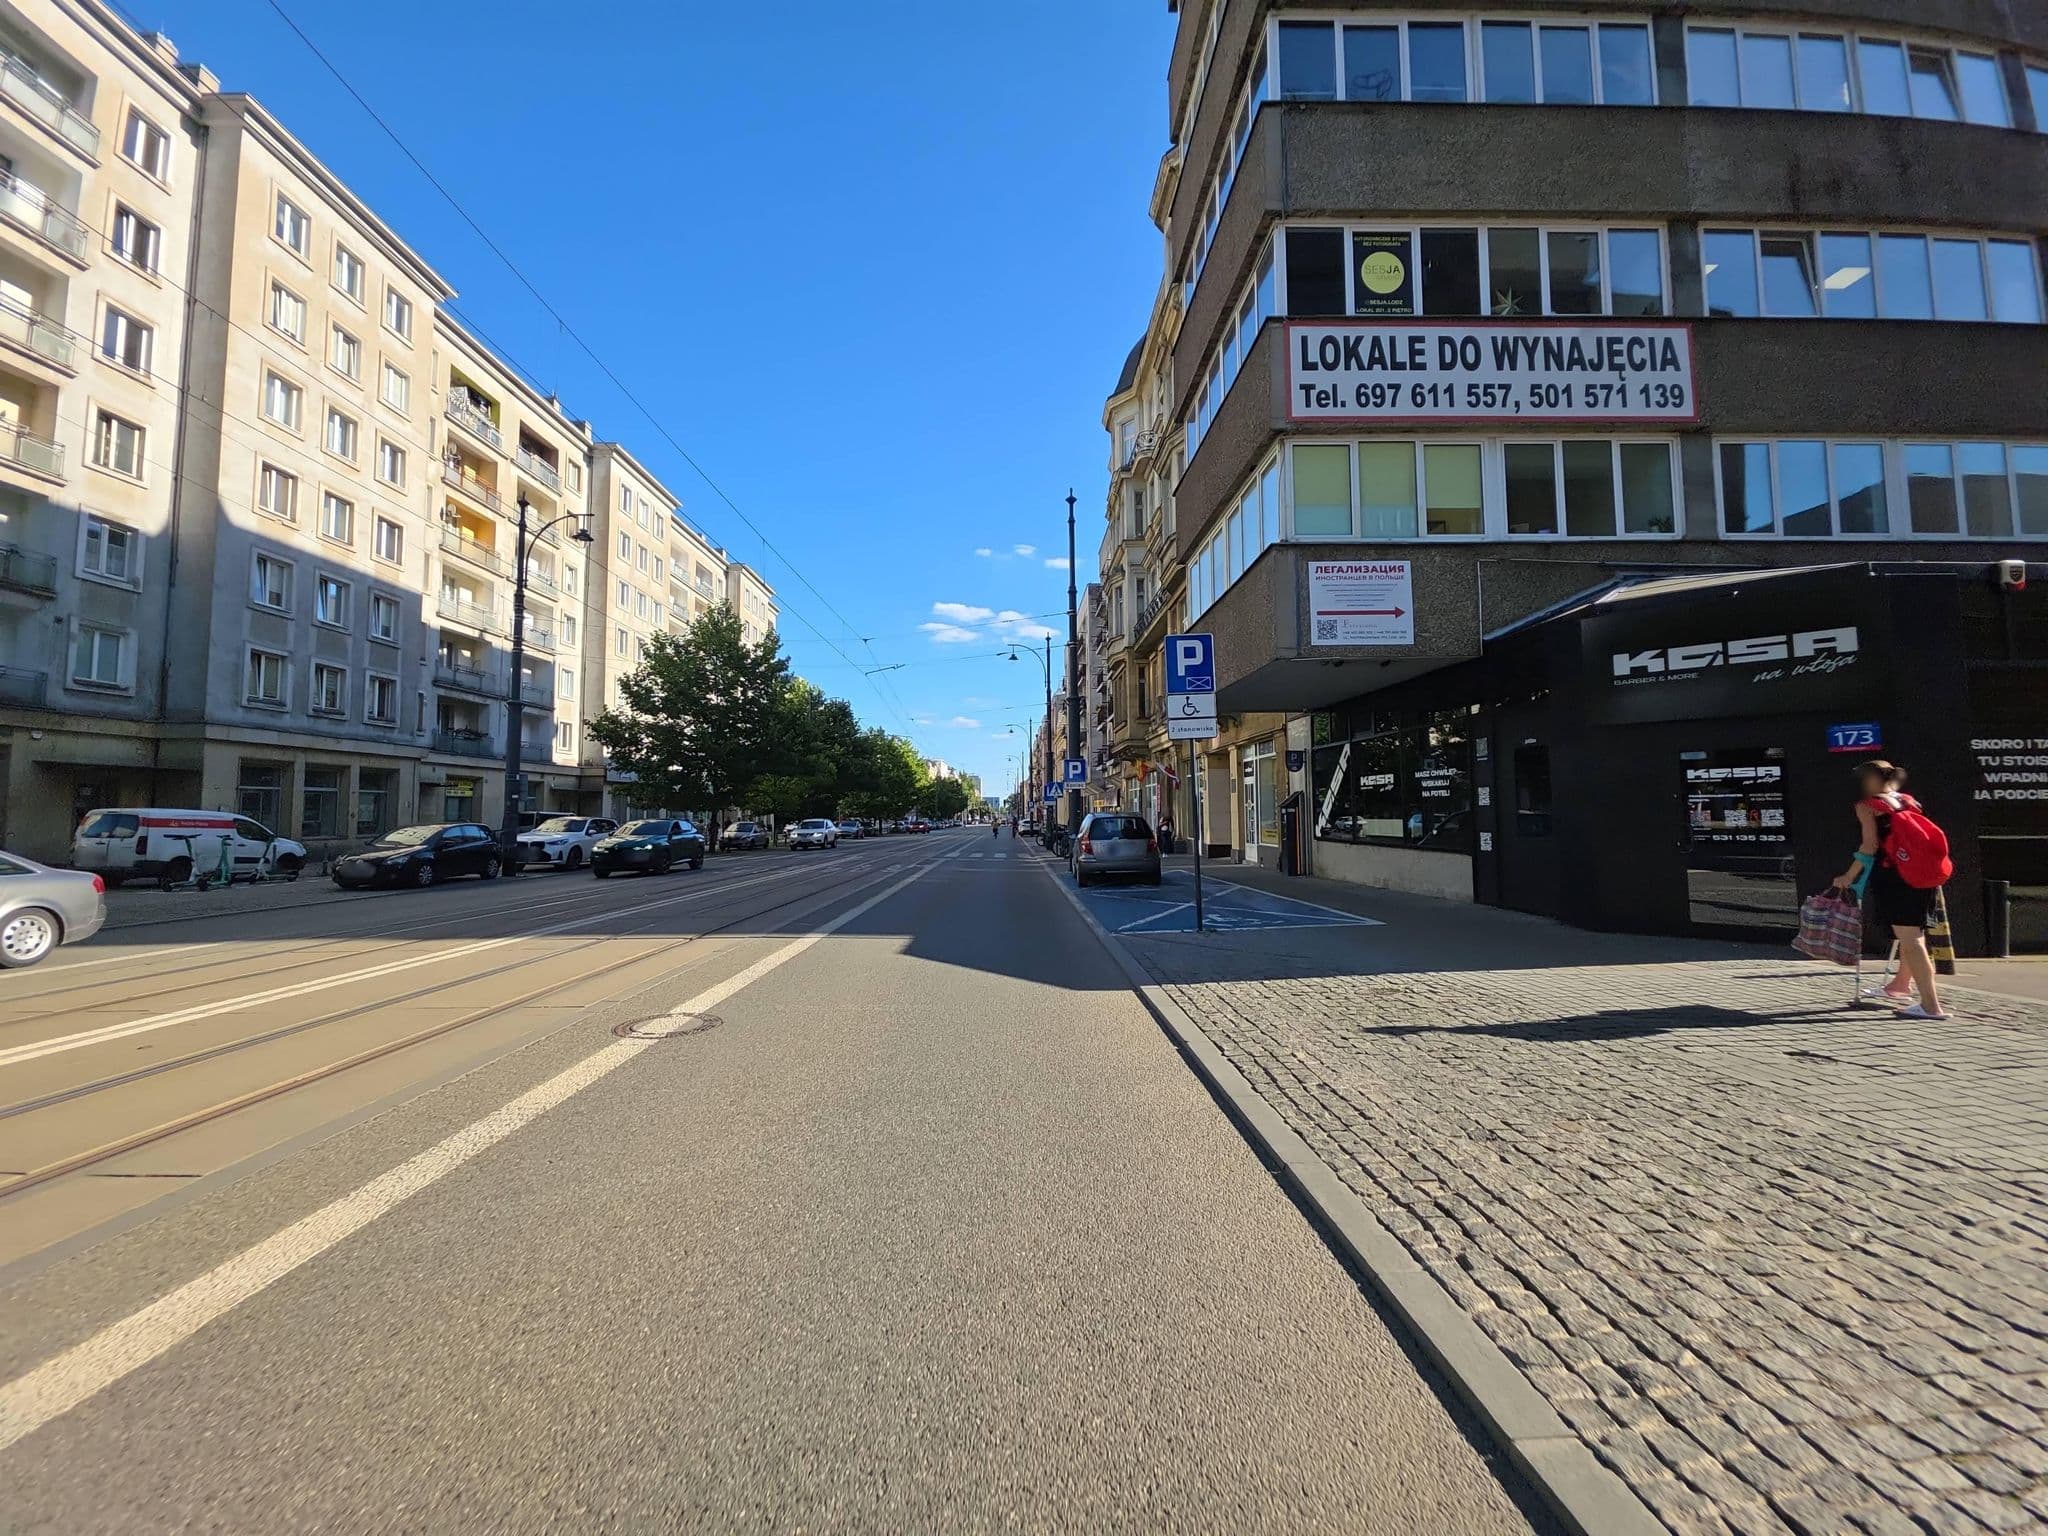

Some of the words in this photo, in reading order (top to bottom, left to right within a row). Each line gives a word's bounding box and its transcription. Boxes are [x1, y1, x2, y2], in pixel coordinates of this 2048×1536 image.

[1364, 264, 1401, 274] SESJA
[1300, 334, 1427, 372] LOKALE
[1438, 335, 1482, 371] DO
[1491, 335, 1682, 381] WYNAJĘCIA
[1299, 383, 1347, 408] Tel.
[1355, 383, 1402, 408] 697
[1411, 383, 1455, 408] 611
[1466, 383, 1521, 413] 557,
[1529, 383, 1574, 408] 501
[1585, 383, 1628, 408] 571
[1640, 383, 1685, 408] 139
[1315, 565, 1405, 574] ЛЕГАЛИЗАЦИЯ
[1176, 639, 1203, 676] P
[1614, 676, 1656, 686] BARBER
[1667, 672, 1698, 681] MORE
[1834, 730, 1874, 745] 173
[1970, 739, 2024, 749] SKORO
[1977, 755, 2000, 766] TU
[1068, 761, 1082, 778] P
